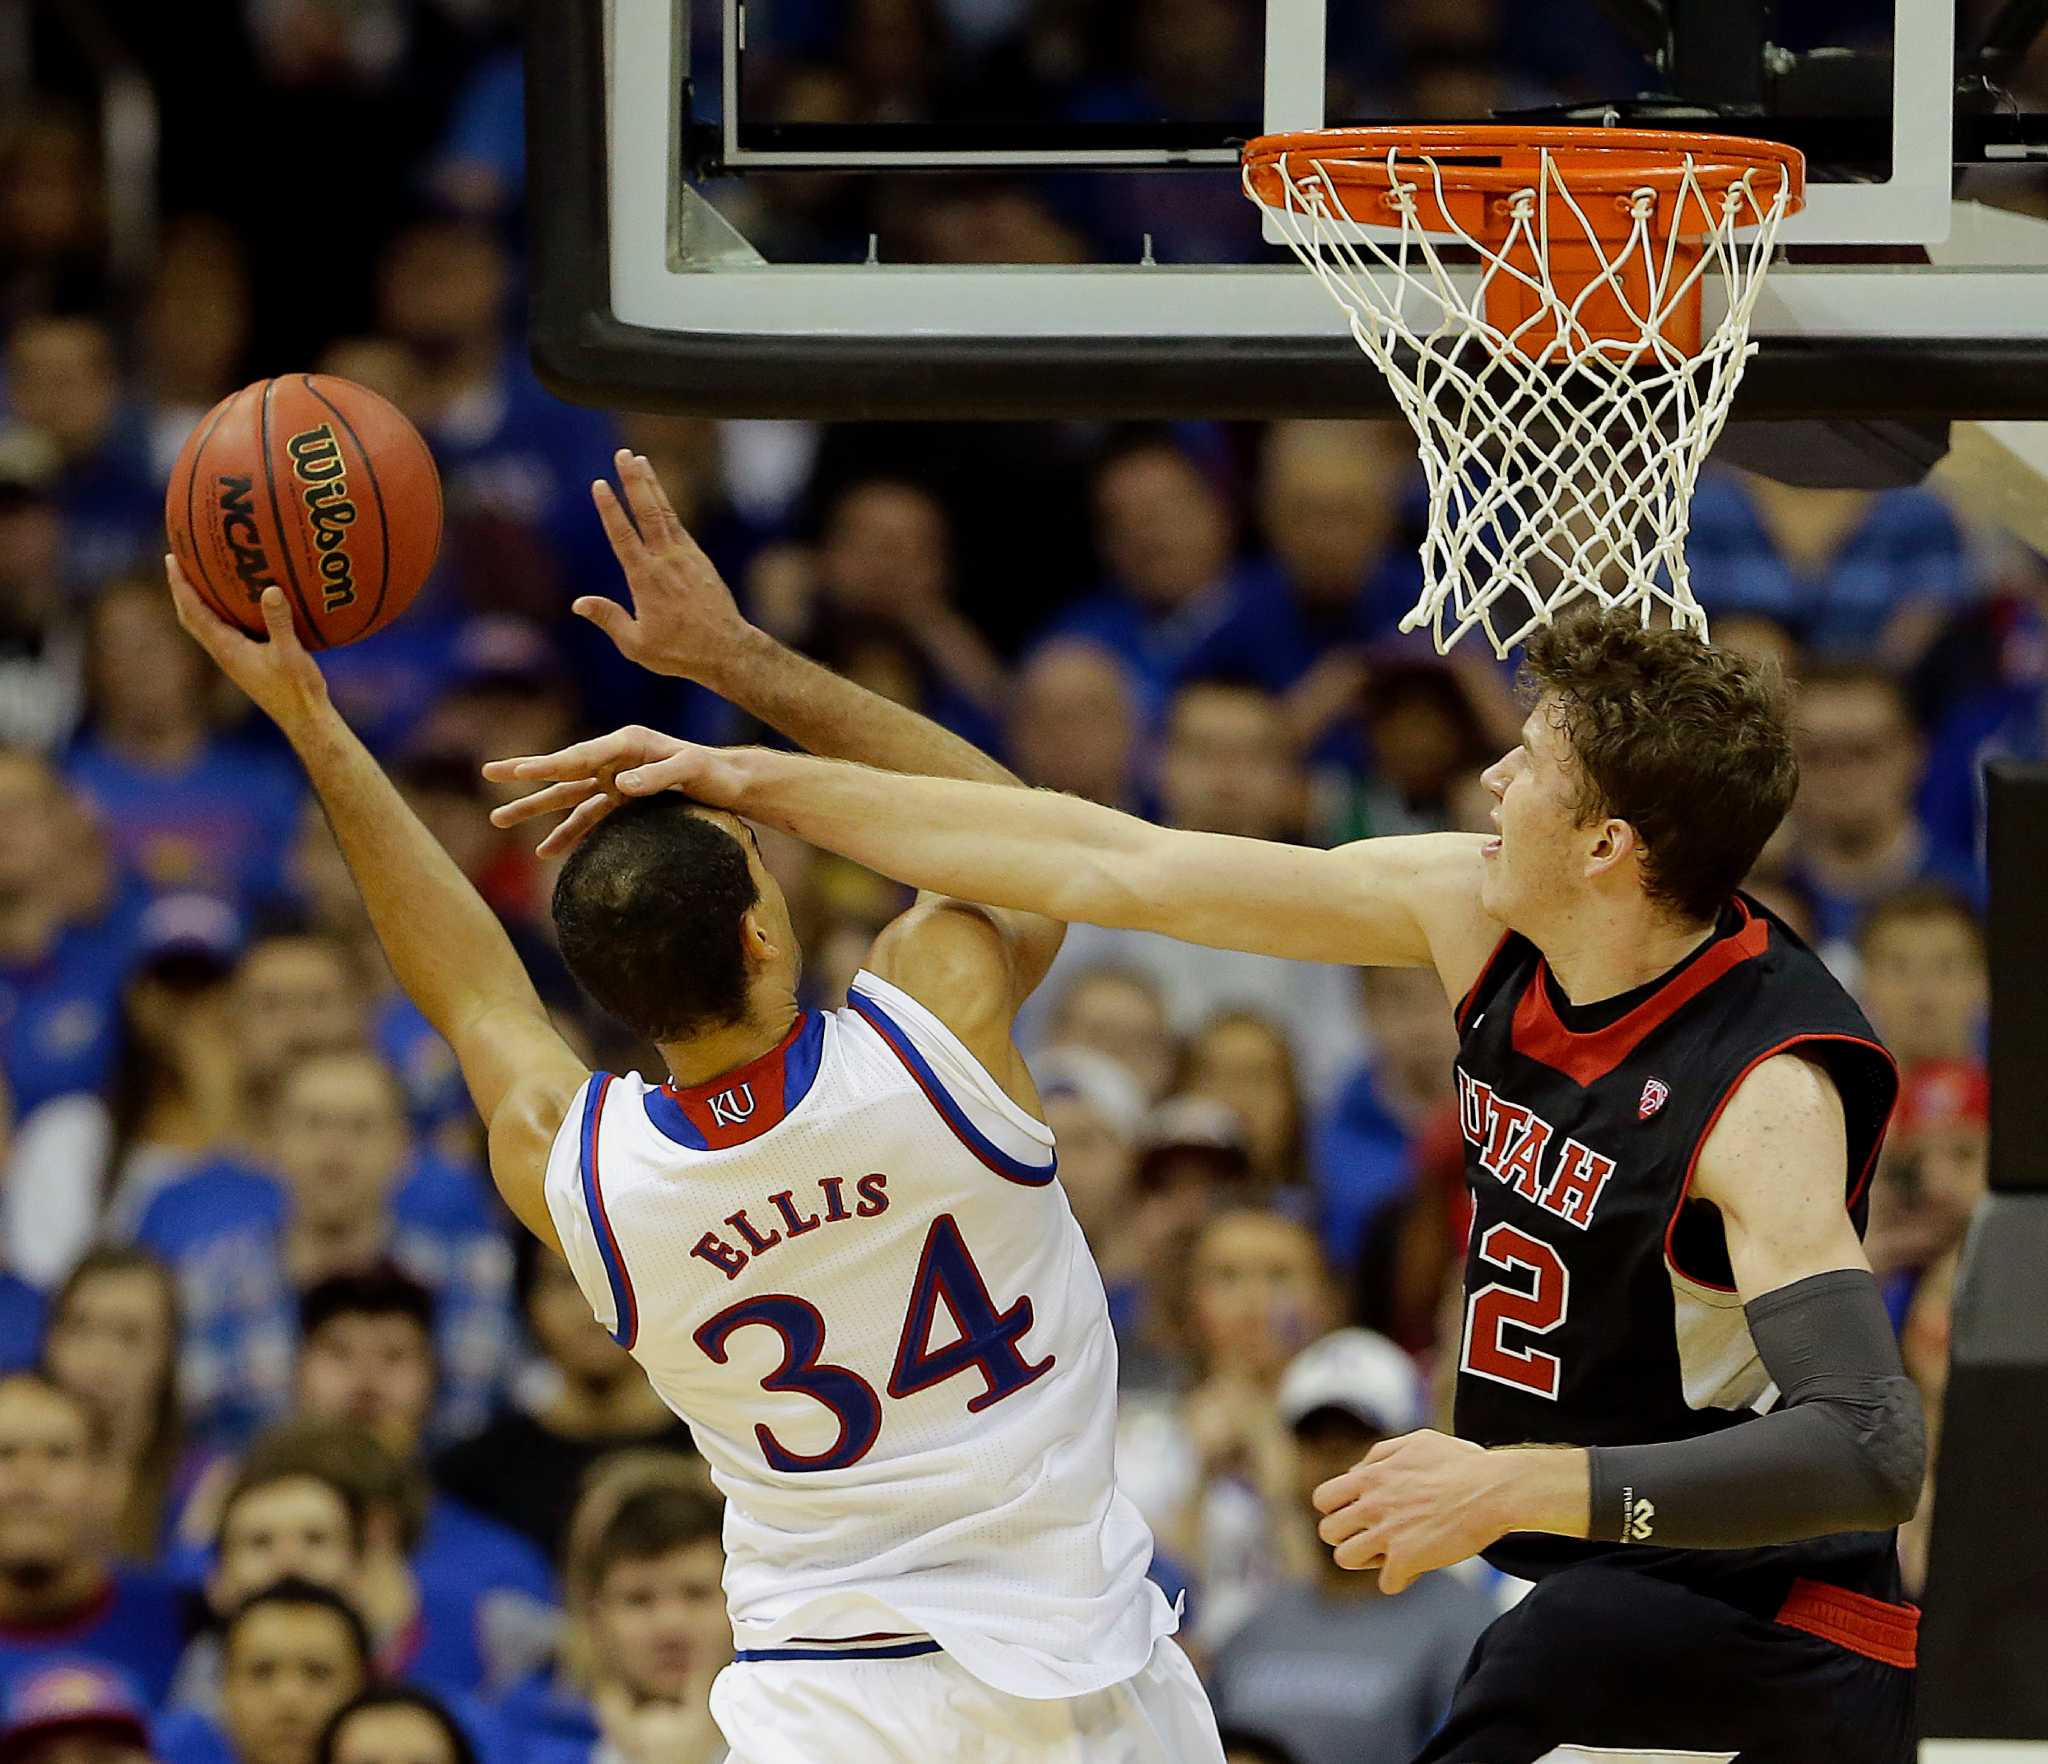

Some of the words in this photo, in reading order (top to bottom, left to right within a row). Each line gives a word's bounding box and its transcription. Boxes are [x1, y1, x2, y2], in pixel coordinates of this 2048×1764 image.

[287, 423, 357, 614] Wilson
[705, 1082, 755, 1127] KU
[1457, 1065, 1617, 1231] UTAH
[689, 1173, 890, 1281] ELLIS
[1459, 1190, 1570, 1401] 2
[692, 1212, 1056, 1473] 34
